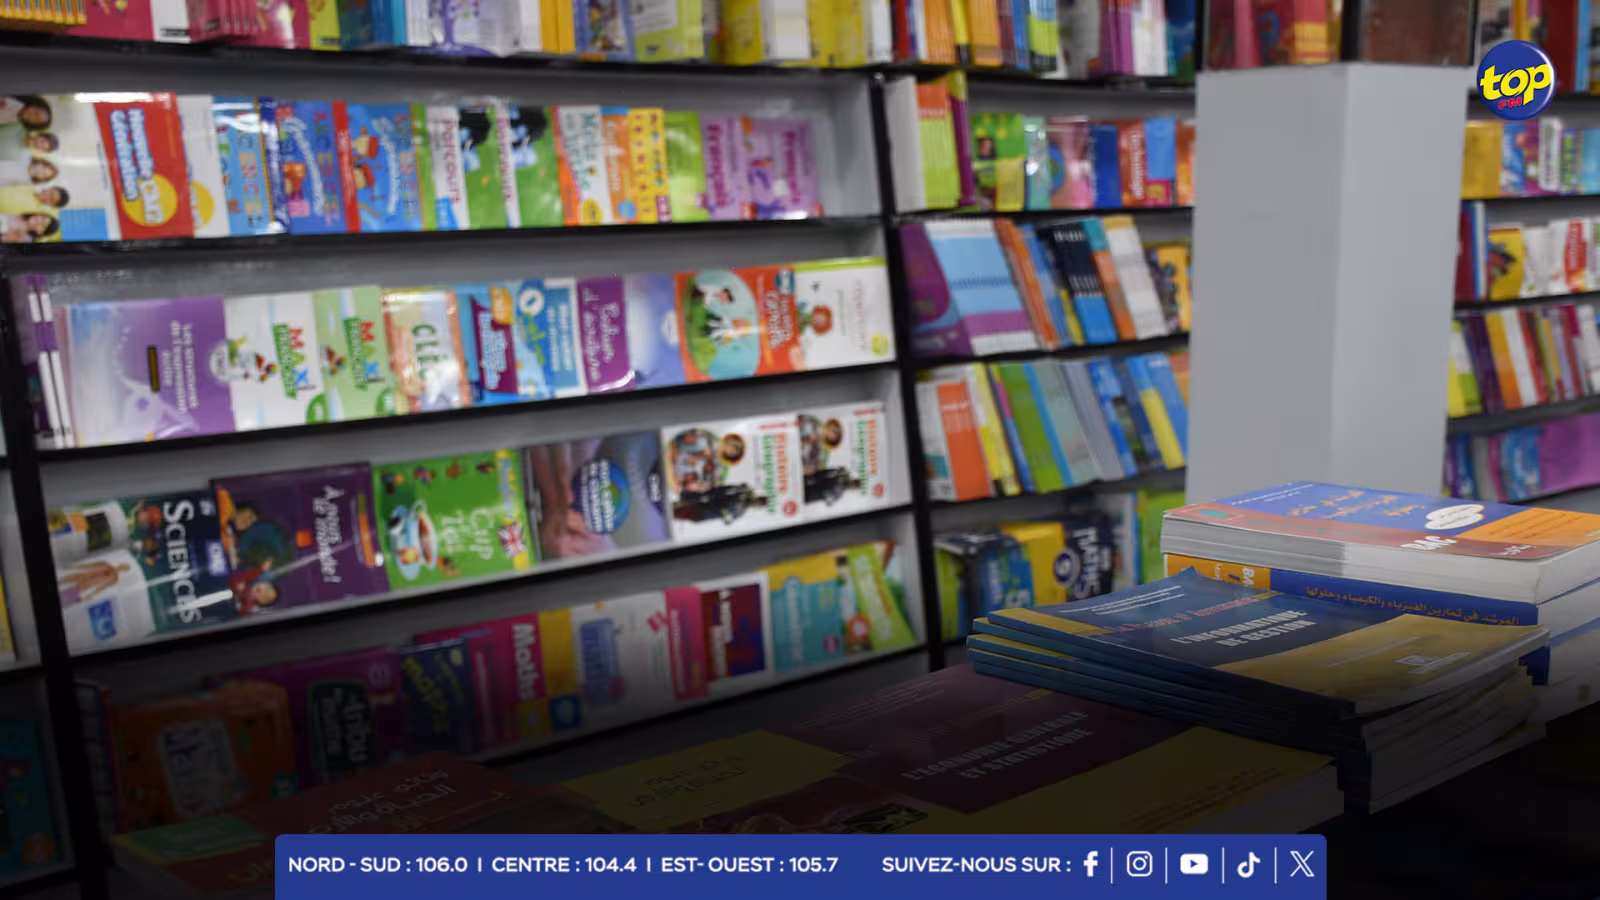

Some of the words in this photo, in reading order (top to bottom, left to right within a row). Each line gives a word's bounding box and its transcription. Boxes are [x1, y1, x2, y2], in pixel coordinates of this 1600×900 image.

[1400, 535, 1457, 550] BAC
[1242, 567, 1255, 587] BA
[1170, 609, 1308, 644] L'INFORMATIQUE
[1464, 612, 1479, 622] في
[1216, 635, 1248, 647] DE
[1246, 619, 1318, 642] GESTION
[512, 623, 538, 700] Maths
